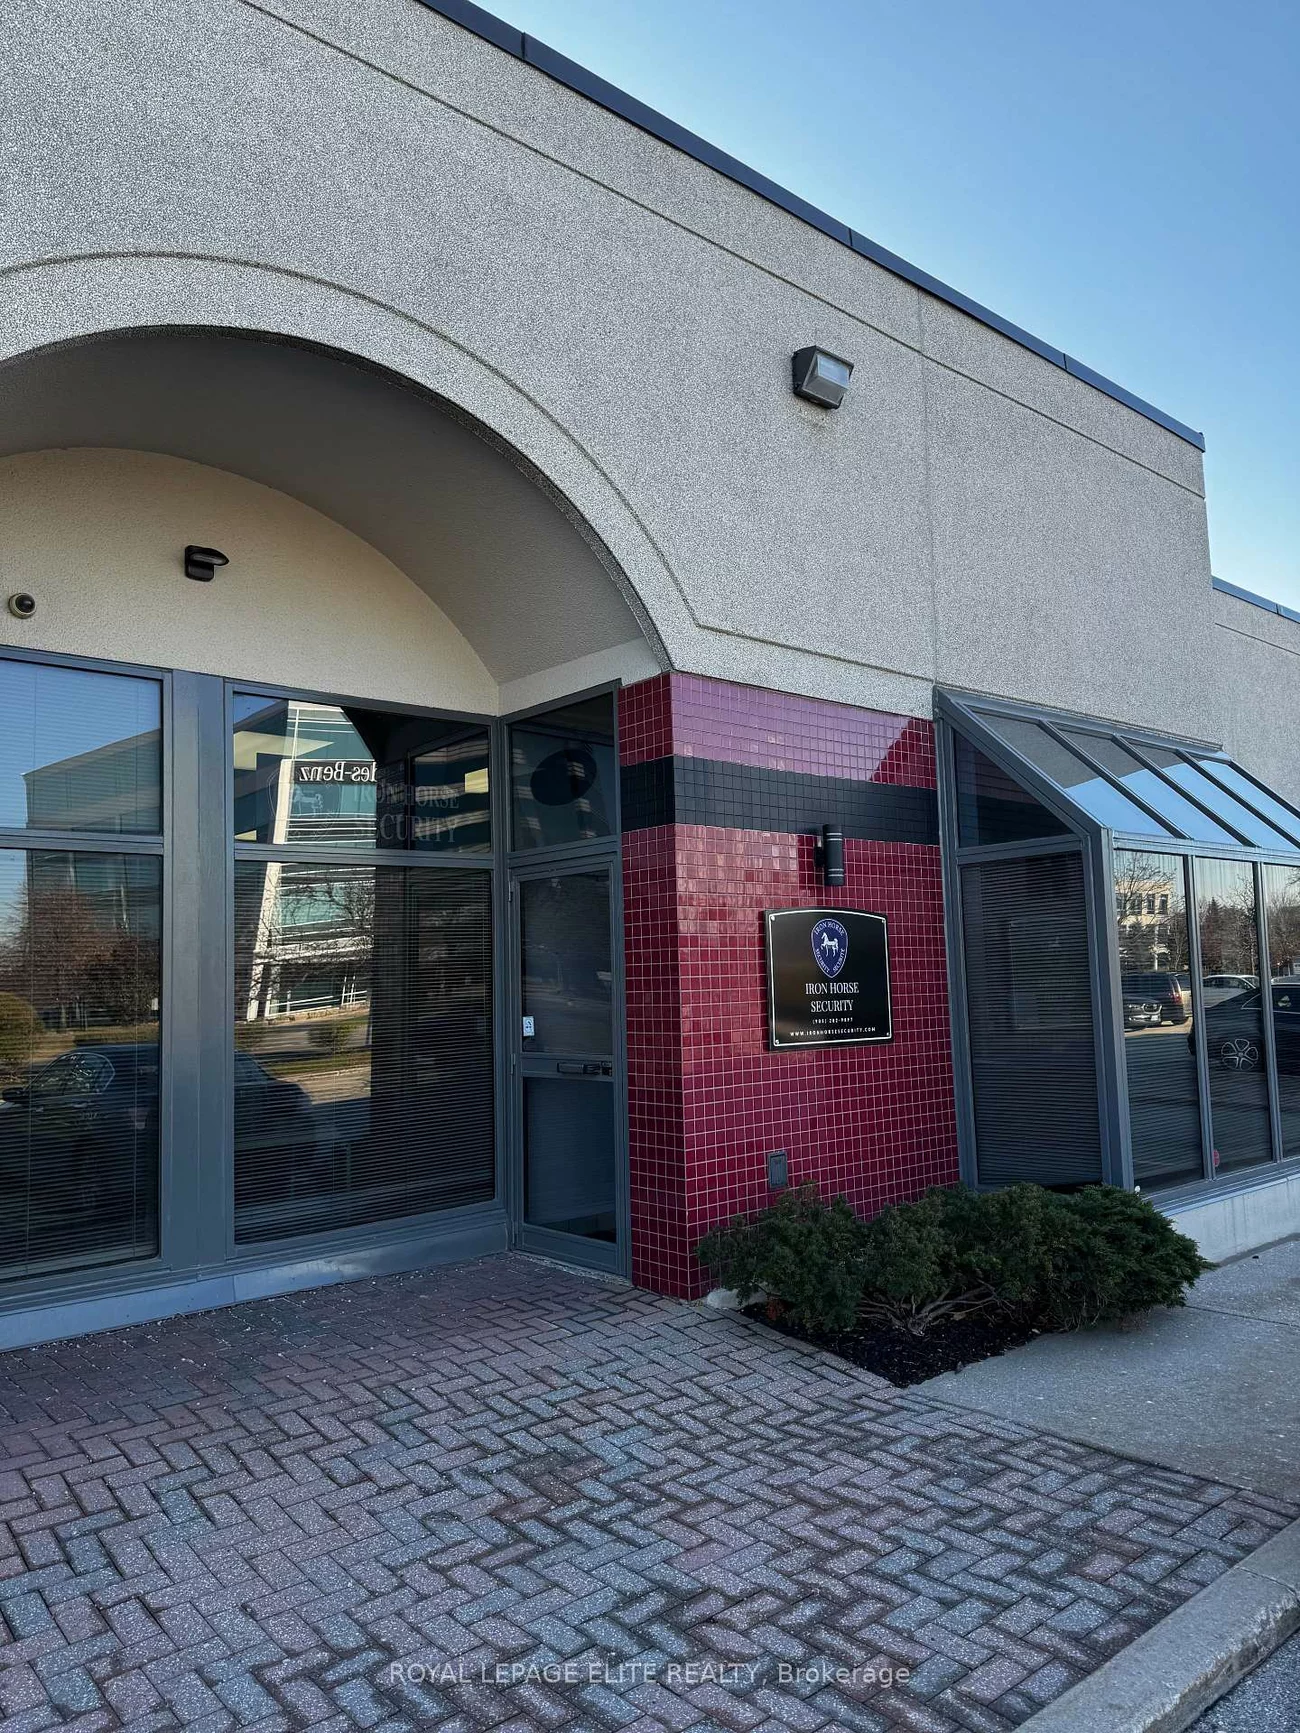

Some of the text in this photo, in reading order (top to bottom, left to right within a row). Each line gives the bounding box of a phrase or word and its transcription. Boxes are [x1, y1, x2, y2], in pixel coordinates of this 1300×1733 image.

[805, 982, 859, 995] IRON HORSE
[810, 1000, 853, 1012] SECURITY
